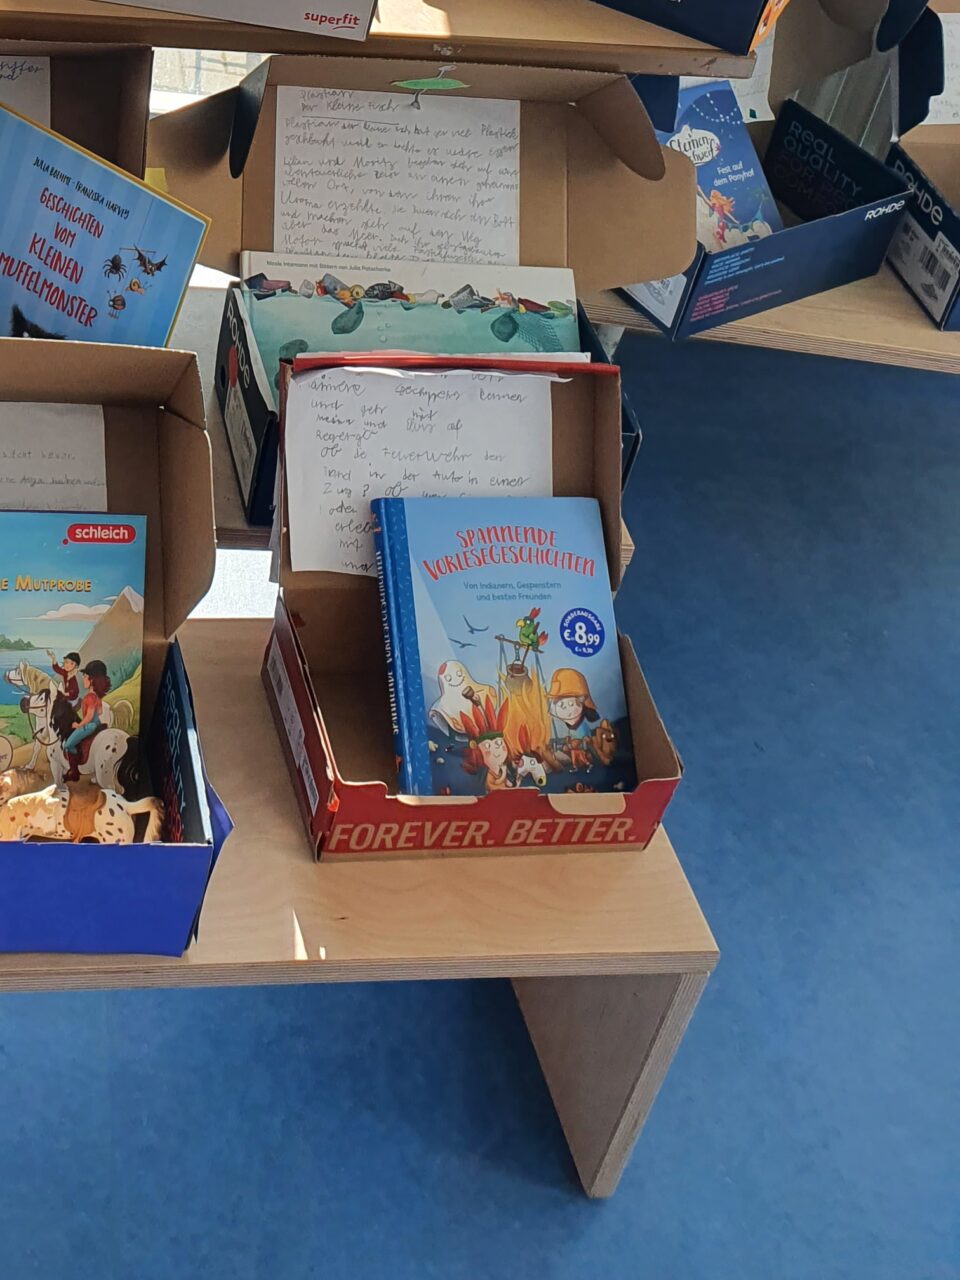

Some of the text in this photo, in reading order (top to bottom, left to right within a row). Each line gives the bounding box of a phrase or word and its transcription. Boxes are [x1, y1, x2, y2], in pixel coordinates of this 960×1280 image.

[304, 12, 360, 26] superfit
[713, 168, 754, 187] dem Ponyhof
[717, 160, 743, 175] Fest auf
[76, 181, 105, 207] FRANZISKA
[105, 198, 130, 220] HARVEY
[40, 186, 104, 239] GESCHICHTEN
[54, 221, 76, 248] VOM
[28, 232, 84, 285] KLEINEN
[75, 526, 128, 539] schleich
[455, 525, 558, 548] SPANNENDE
[422, 545, 595, 581] VORLESEGESCHICHTEN
[15, 574, 91, 593] MUTPROBE
[464, 582, 562, 591] Von Indianern, Gespenstern
[477, 592, 552, 601] und besten Freunden
[328, 817, 637, 851] FOREVER. BETTER.
